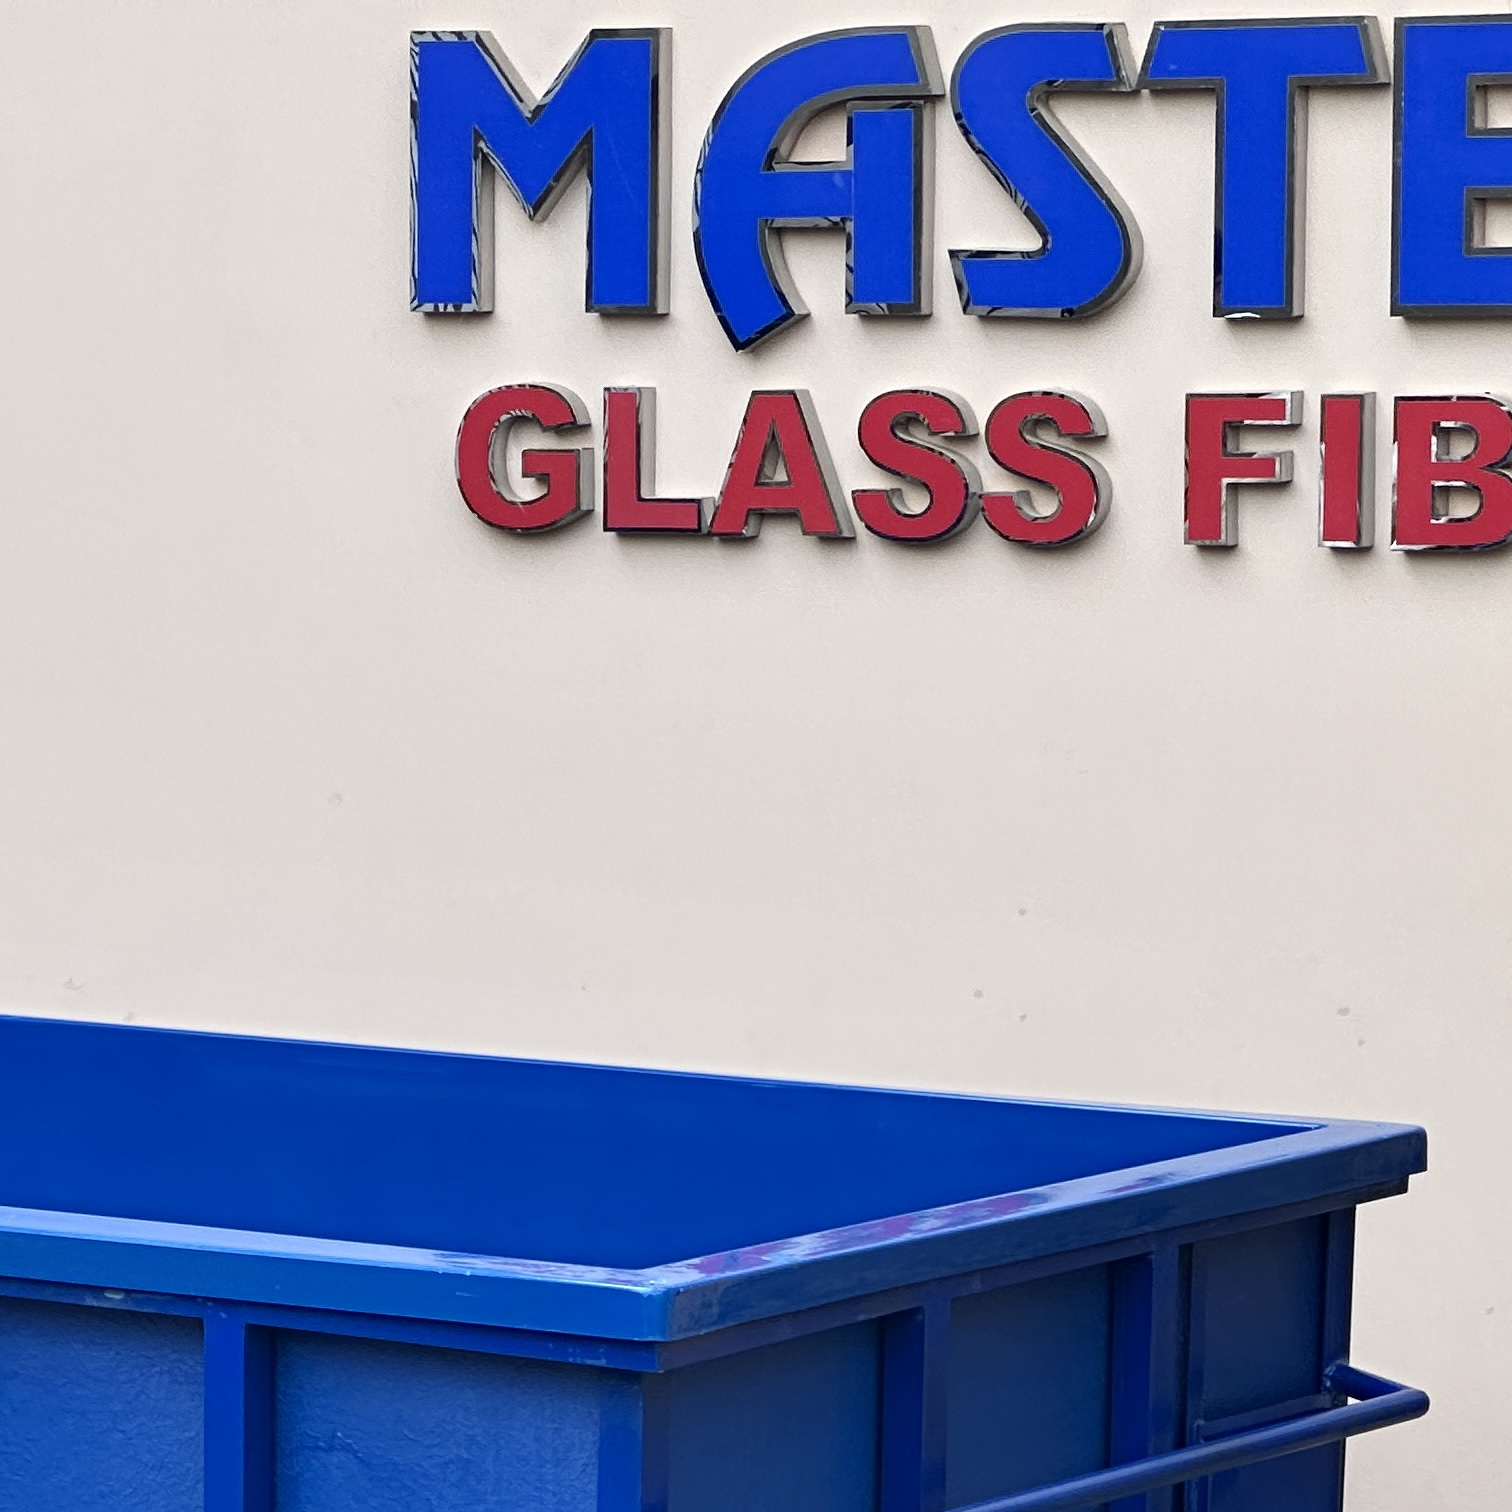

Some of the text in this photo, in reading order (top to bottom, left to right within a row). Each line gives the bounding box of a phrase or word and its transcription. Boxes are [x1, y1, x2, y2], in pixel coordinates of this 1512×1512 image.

[409, 15, 1512, 352] MASTE
[455, 381, 1512, 551] GLASS FIB
